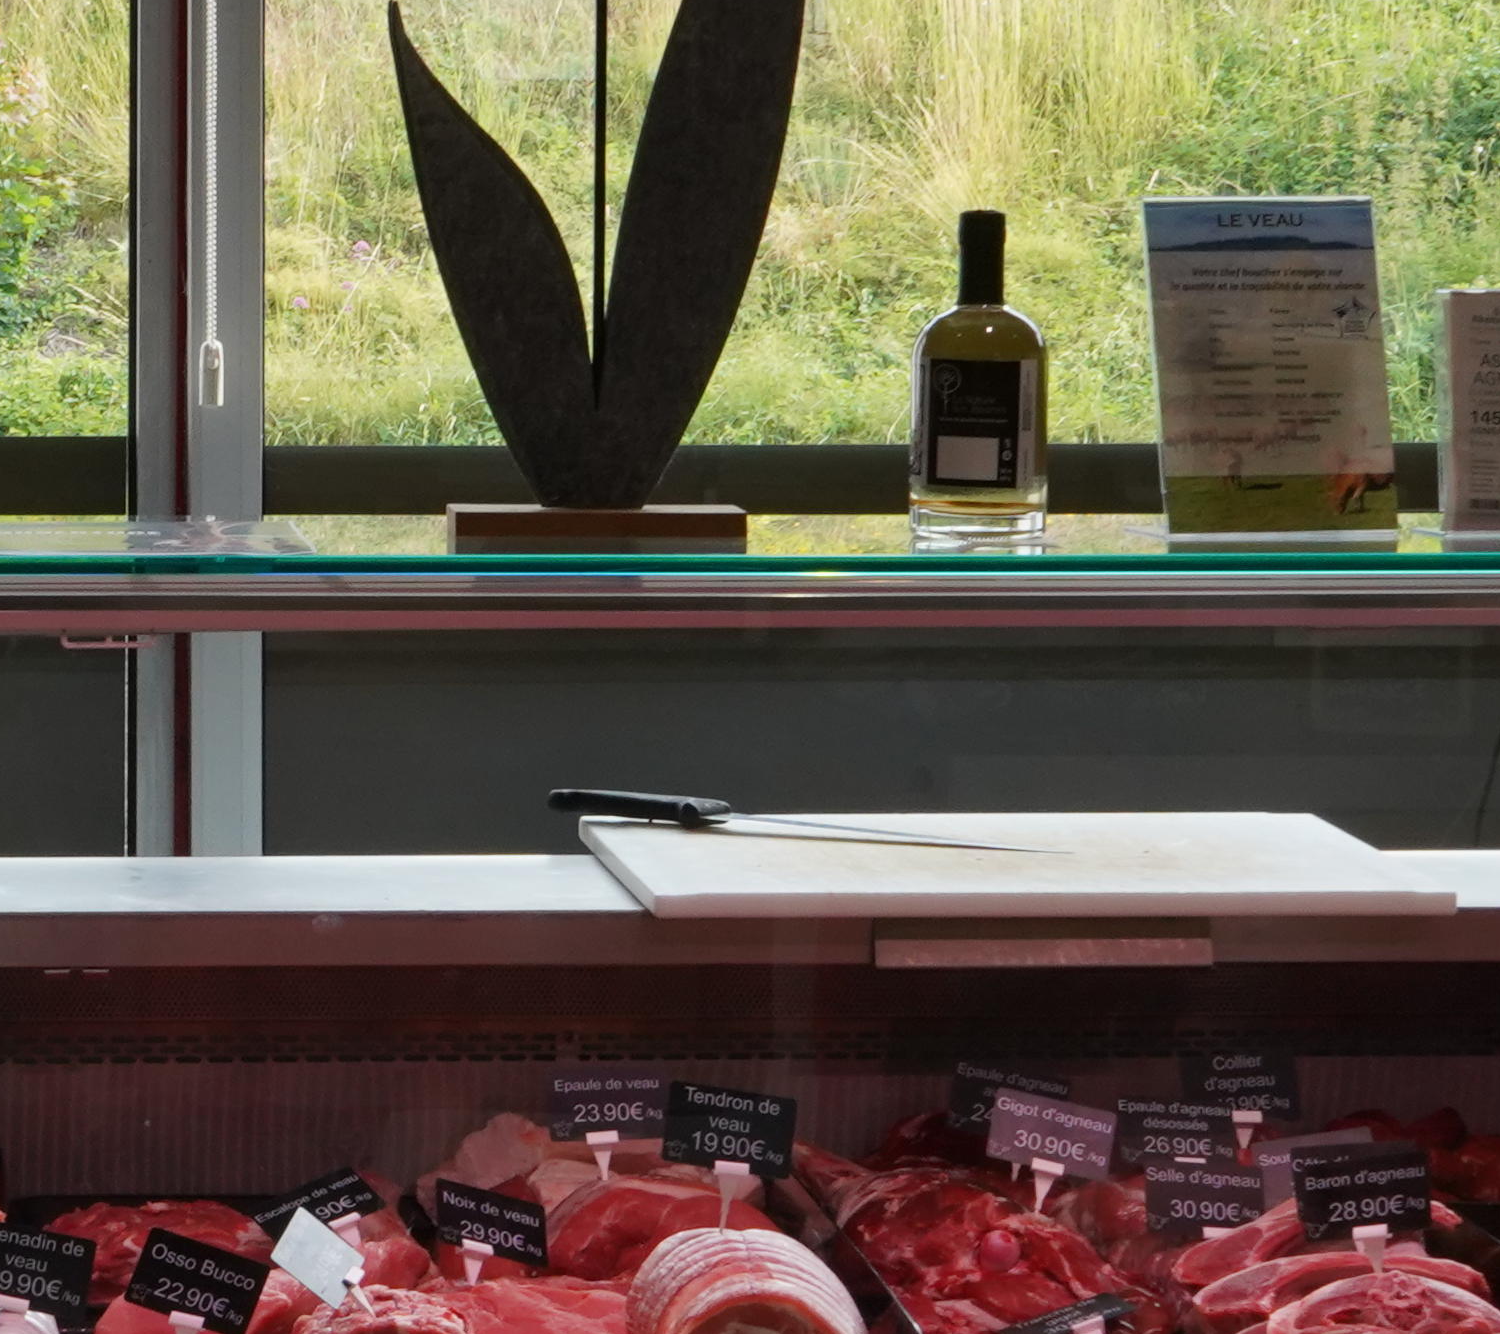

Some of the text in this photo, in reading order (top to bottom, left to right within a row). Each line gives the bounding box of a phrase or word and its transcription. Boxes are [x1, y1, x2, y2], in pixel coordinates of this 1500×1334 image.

[1218, 213, 1304, 228] LE VEAU
[1211, 1054, 1263, 1071] Collier
[553, 1077, 661, 1094] Epaule de veau
[956, 1061, 1069, 1096] Epaule d'agneau
[1204, 1074, 1277, 1093] d'agneau
[684, 1085, 782, 1117] Tendron de
[1117, 1098, 1232, 1118] Epaule d'agneau
[707, 1115, 751, 1134] veau
[997, 1096, 1114, 1135] Gigot d'agneau
[1142, 1117, 1210, 1132] désossée
[1145, 1167, 1261, 1189] Selle d'agneau
[1304, 1165, 1427, 1191] Baron d'agneau
[254, 1173, 360, 1224] Escalope de veau
[442, 1190, 541, 1229] Noix de veau
[61, 1239, 86, 1259] de
[4, 1252, 49, 1273] veau
[151, 1242, 256, 1291] Osso Bucco
